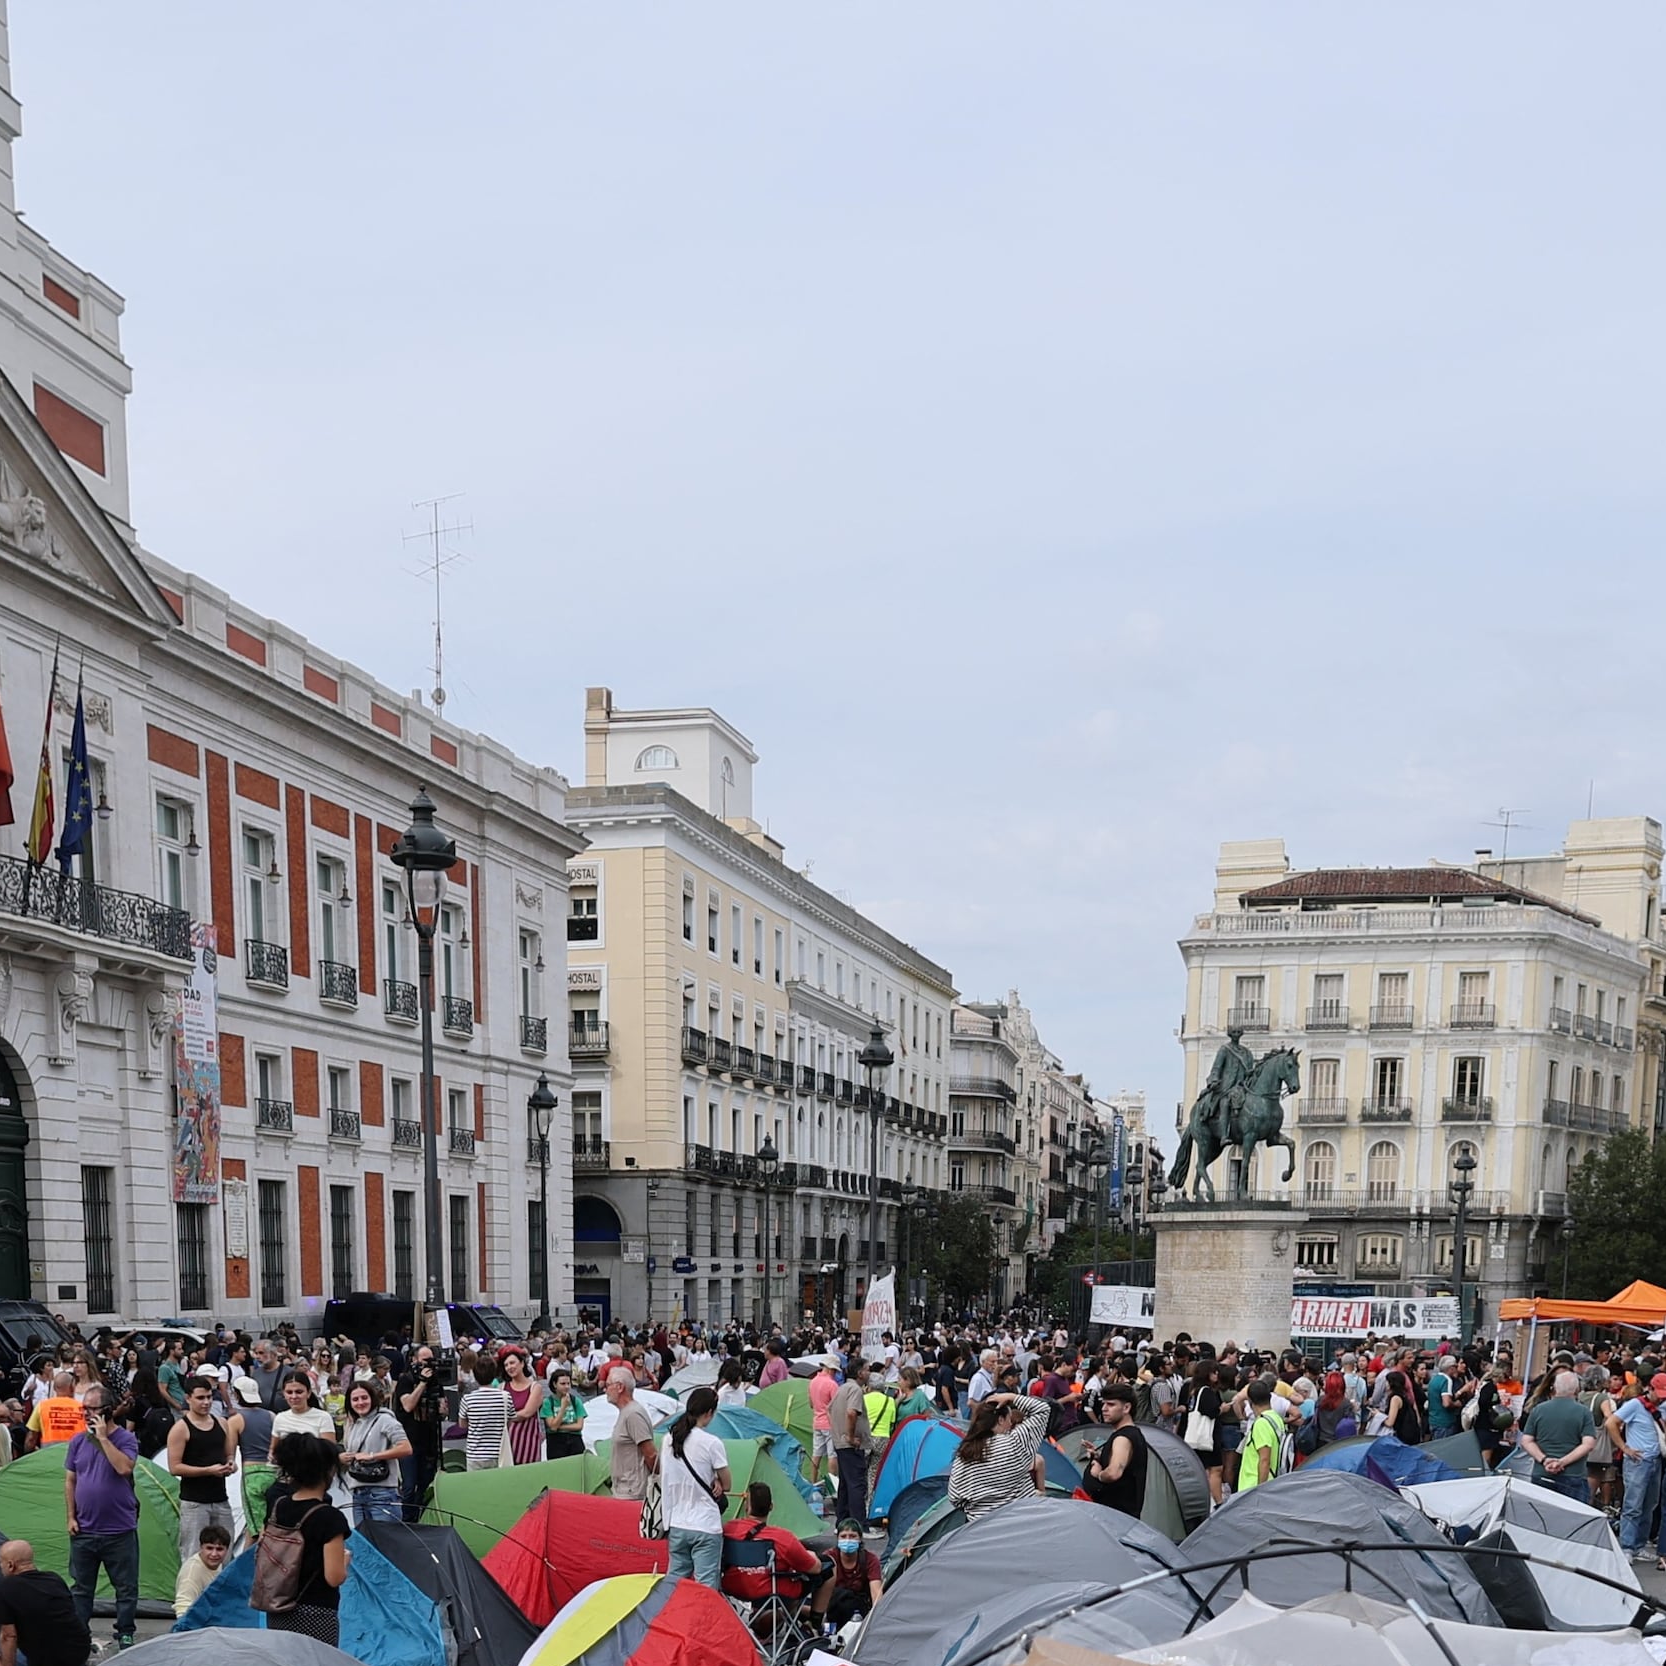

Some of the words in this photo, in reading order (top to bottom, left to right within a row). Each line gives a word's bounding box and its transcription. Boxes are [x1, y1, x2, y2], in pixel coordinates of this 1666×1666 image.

[567, 972, 598, 985] HOSTAL
[184, 988, 201, 1001] DAD
[1141, 1293, 1155, 1316] N
[1292, 1301, 1366, 1327] ARMEN
[1370, 1301, 1417, 1328] MÁS
[1300, 1326, 1353, 1334] CULPABLES
